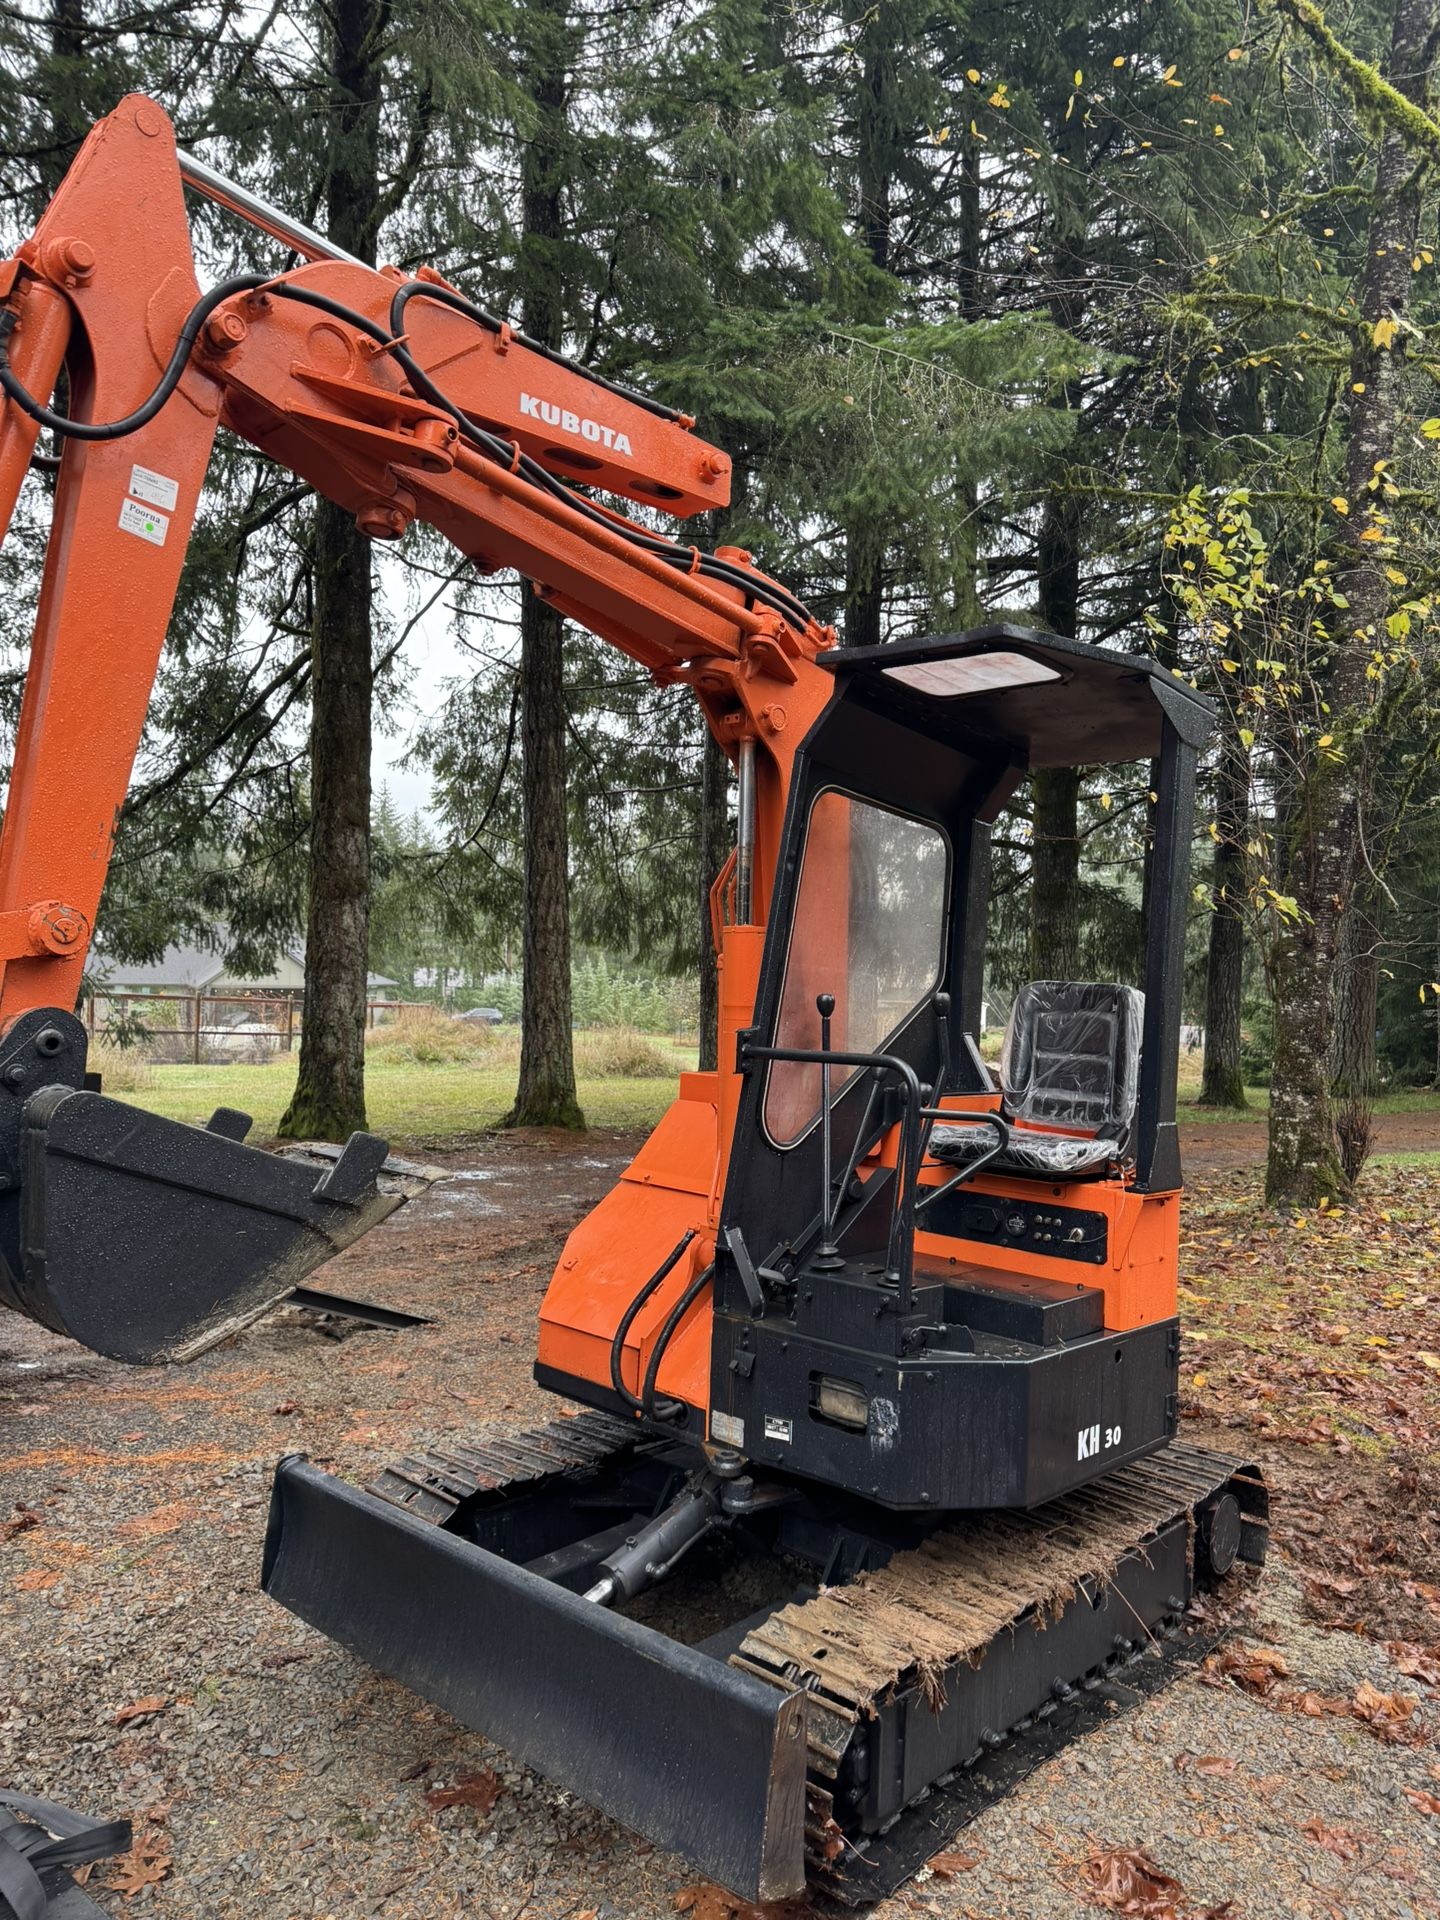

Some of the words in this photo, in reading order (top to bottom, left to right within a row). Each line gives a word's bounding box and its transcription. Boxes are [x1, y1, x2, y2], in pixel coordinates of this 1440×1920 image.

[520, 391, 633, 457] KUBOTA
[129, 503, 161, 524] Poorna
[1077, 1423, 1100, 1461] KH
[1104, 1425, 1121, 1448] 30
